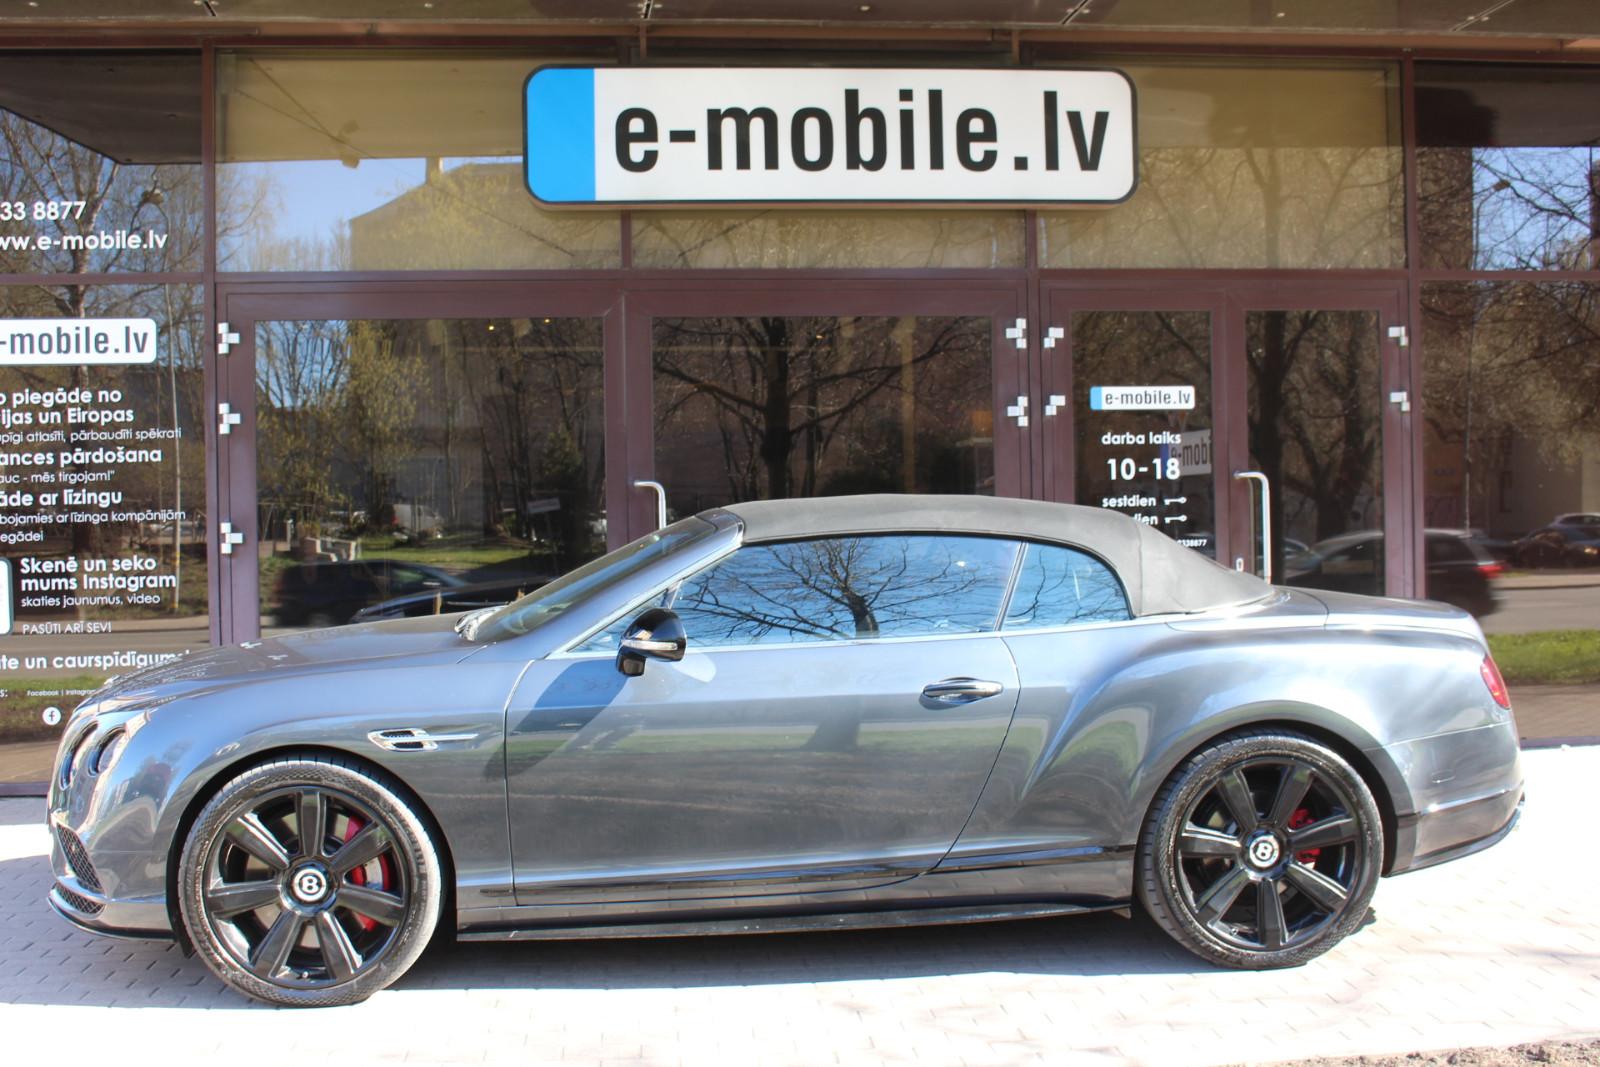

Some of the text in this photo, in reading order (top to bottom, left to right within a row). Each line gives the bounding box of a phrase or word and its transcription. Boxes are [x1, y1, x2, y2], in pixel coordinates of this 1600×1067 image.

[614, 88, 1110, 173] e-mobile.lv
[33, 200, 87, 220] 8877
[12, 387, 93, 408] piegāde
[98, 389, 122, 403] no
[1105, 390, 1190, 405] e-mobile.lv
[0, 407, 134, 429] ijas un Eiropas
[70, 428, 133, 443] pārbaudīti
[135, 427, 182, 441] spēkrati
[1101, 431, 1181, 445] darba laiks
[60, 446, 162, 468] pārdošana
[1107, 457, 1180, 480] 10-18
[31, 472, 55, 483] mēs
[39, 493, 58, 506] ar
[63, 488, 122, 508] līzingu
[1102, 495, 1156, 508] sestdien
[56, 514, 69, 523] ar
[70, 512, 109, 525] līzinga
[111, 509, 186, 524] kompānijām
[20, 555, 156, 574] Skenē un seko
[21, 573, 176, 592] mums Instagram
[21, 595, 61, 607] skaties
[127, 593, 161, 604] video
[22, 621, 61, 635] PASŪTI
[64, 619, 84, 633] ARĪ
[25, 656, 48, 669] un
